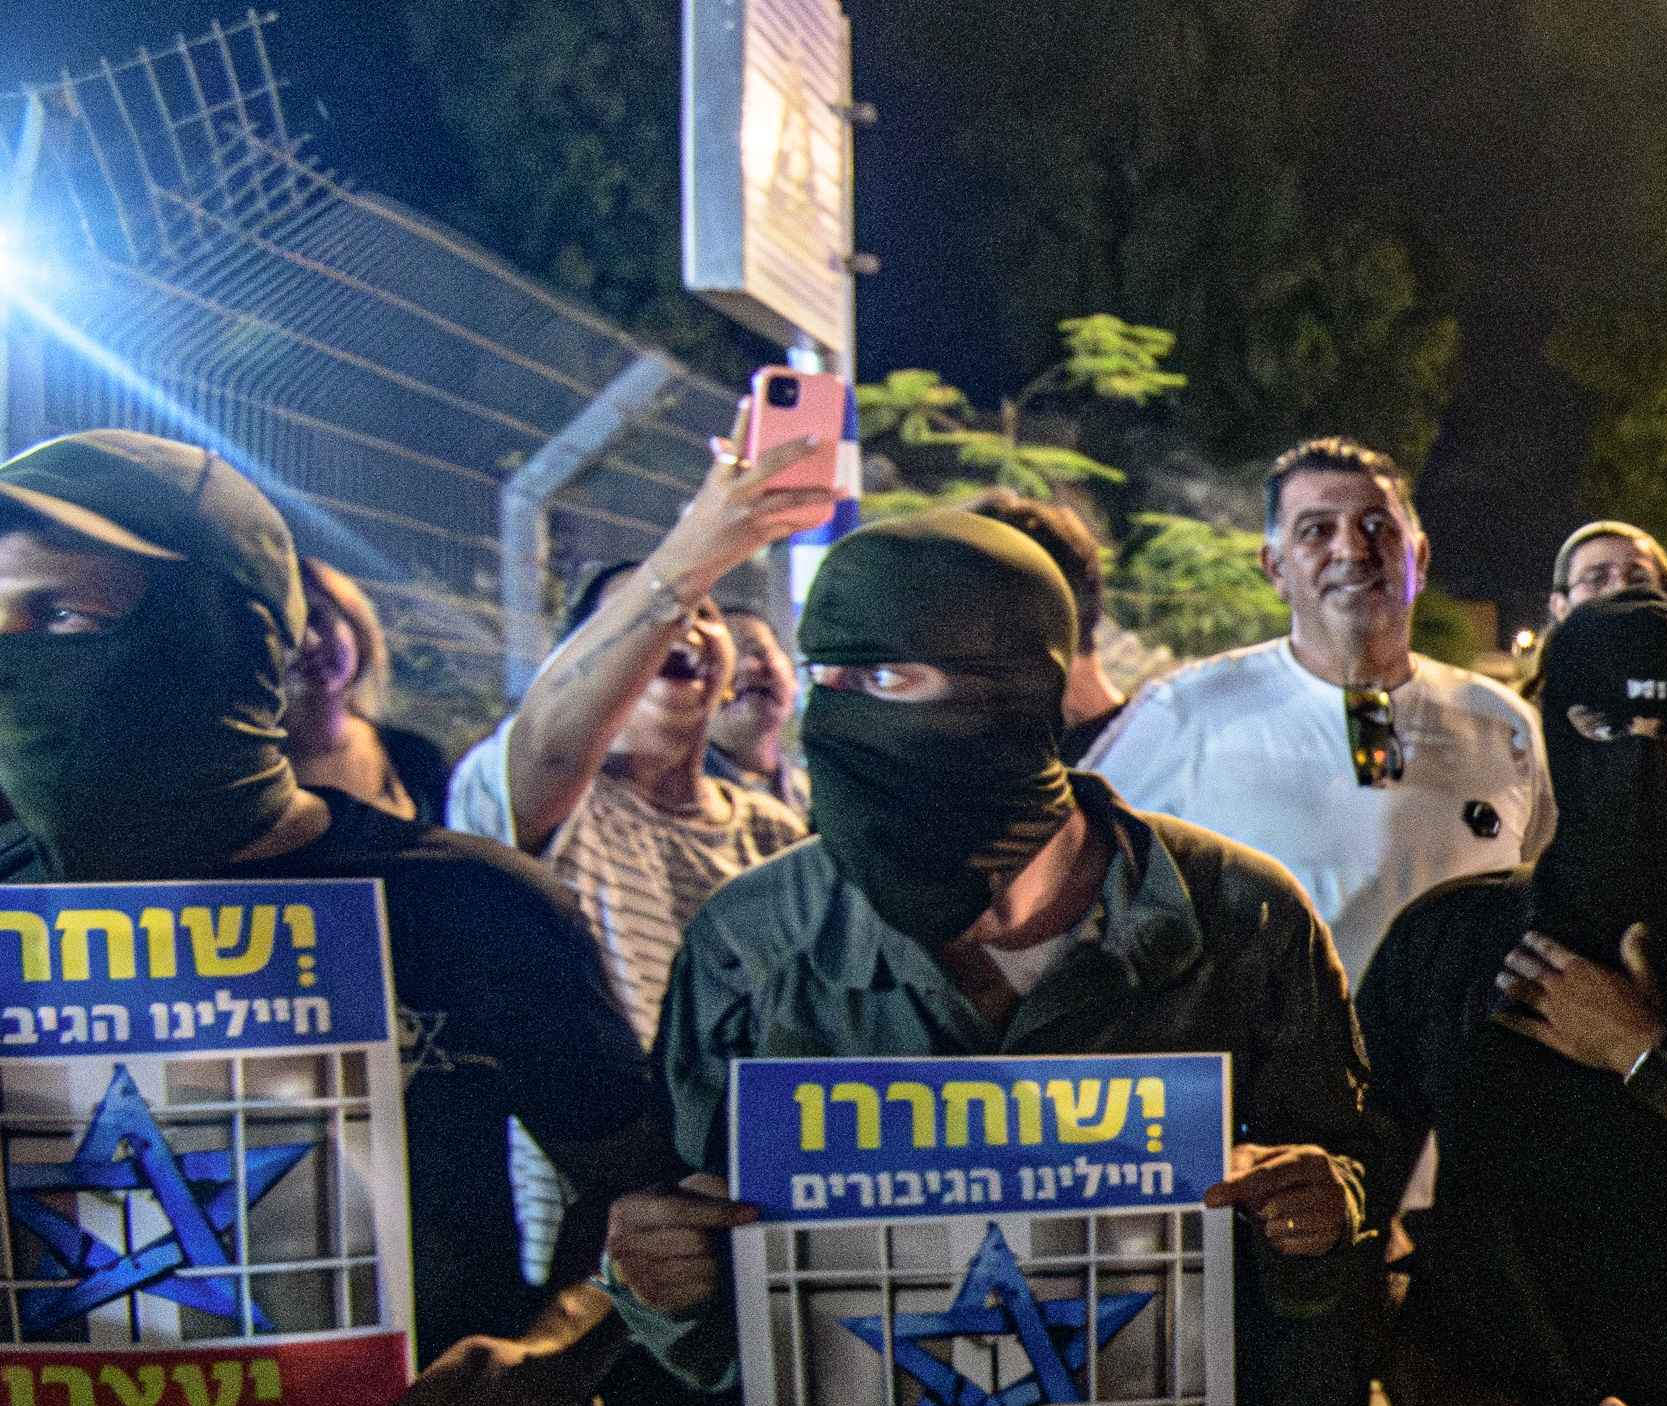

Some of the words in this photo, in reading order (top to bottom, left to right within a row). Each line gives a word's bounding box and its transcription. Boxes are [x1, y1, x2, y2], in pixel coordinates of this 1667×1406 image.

[150, 989, 331, 1040] חיילינו
[790, 1164, 1002, 1211] הגיבורים
[1019, 1155, 1173, 1200] חיילינו
